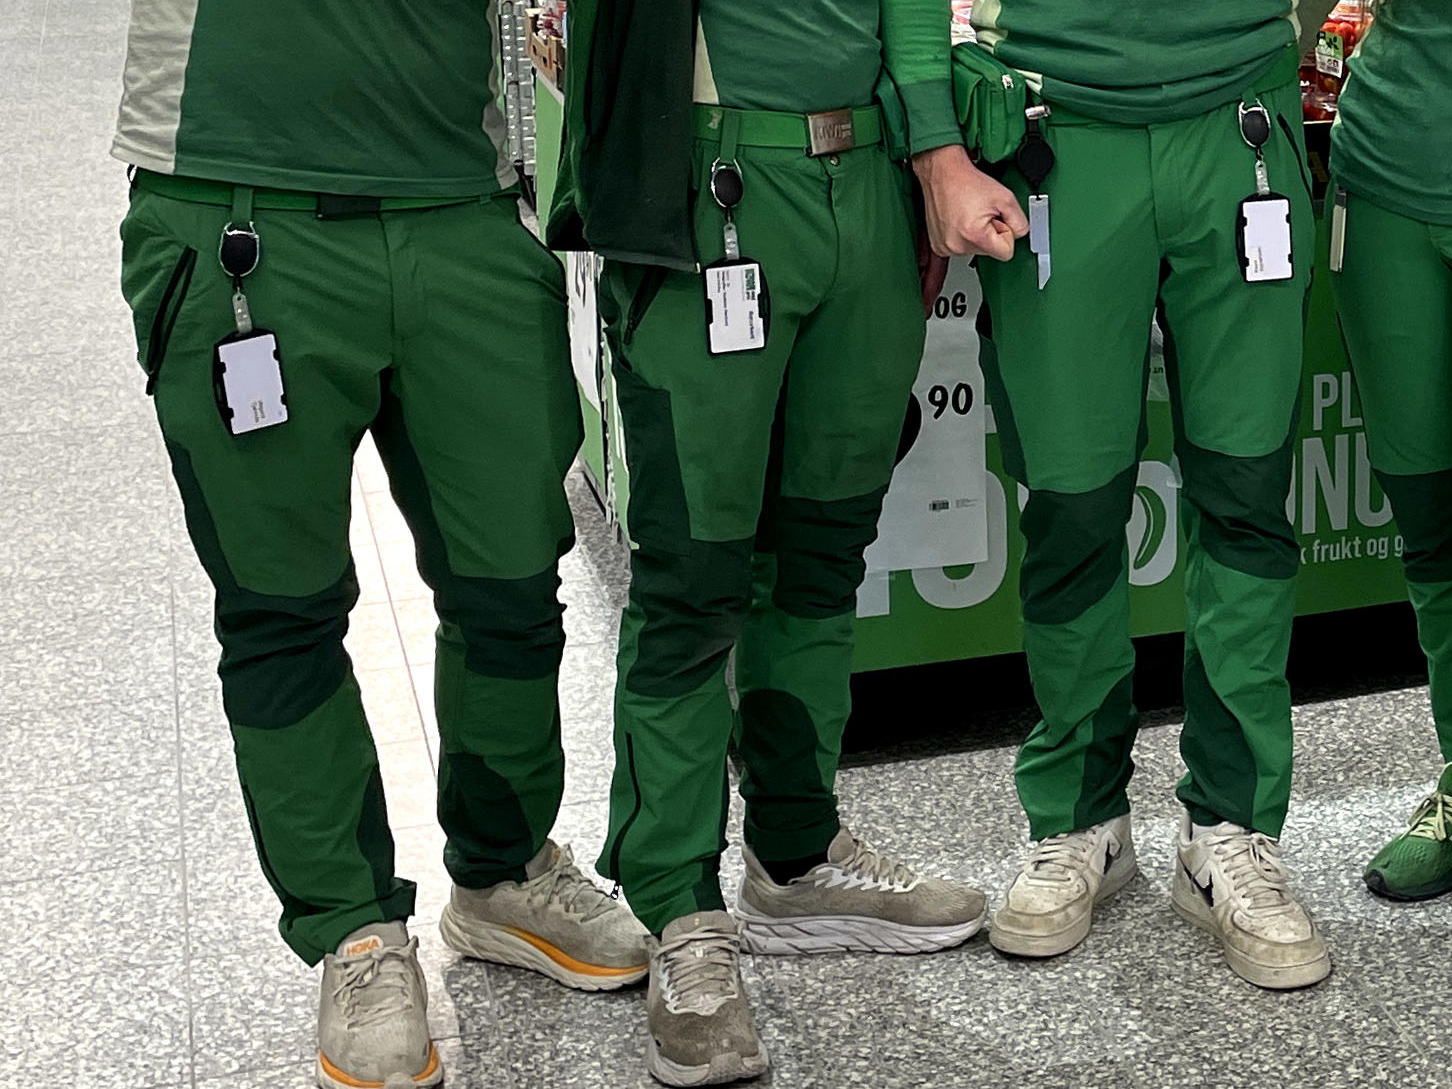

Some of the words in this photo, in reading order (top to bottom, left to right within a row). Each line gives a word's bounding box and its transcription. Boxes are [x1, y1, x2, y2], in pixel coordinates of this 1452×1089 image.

[928, 382, 973, 420] 90
[1312, 535, 1362, 565] frukt
[1366, 534, 1390, 560] og
